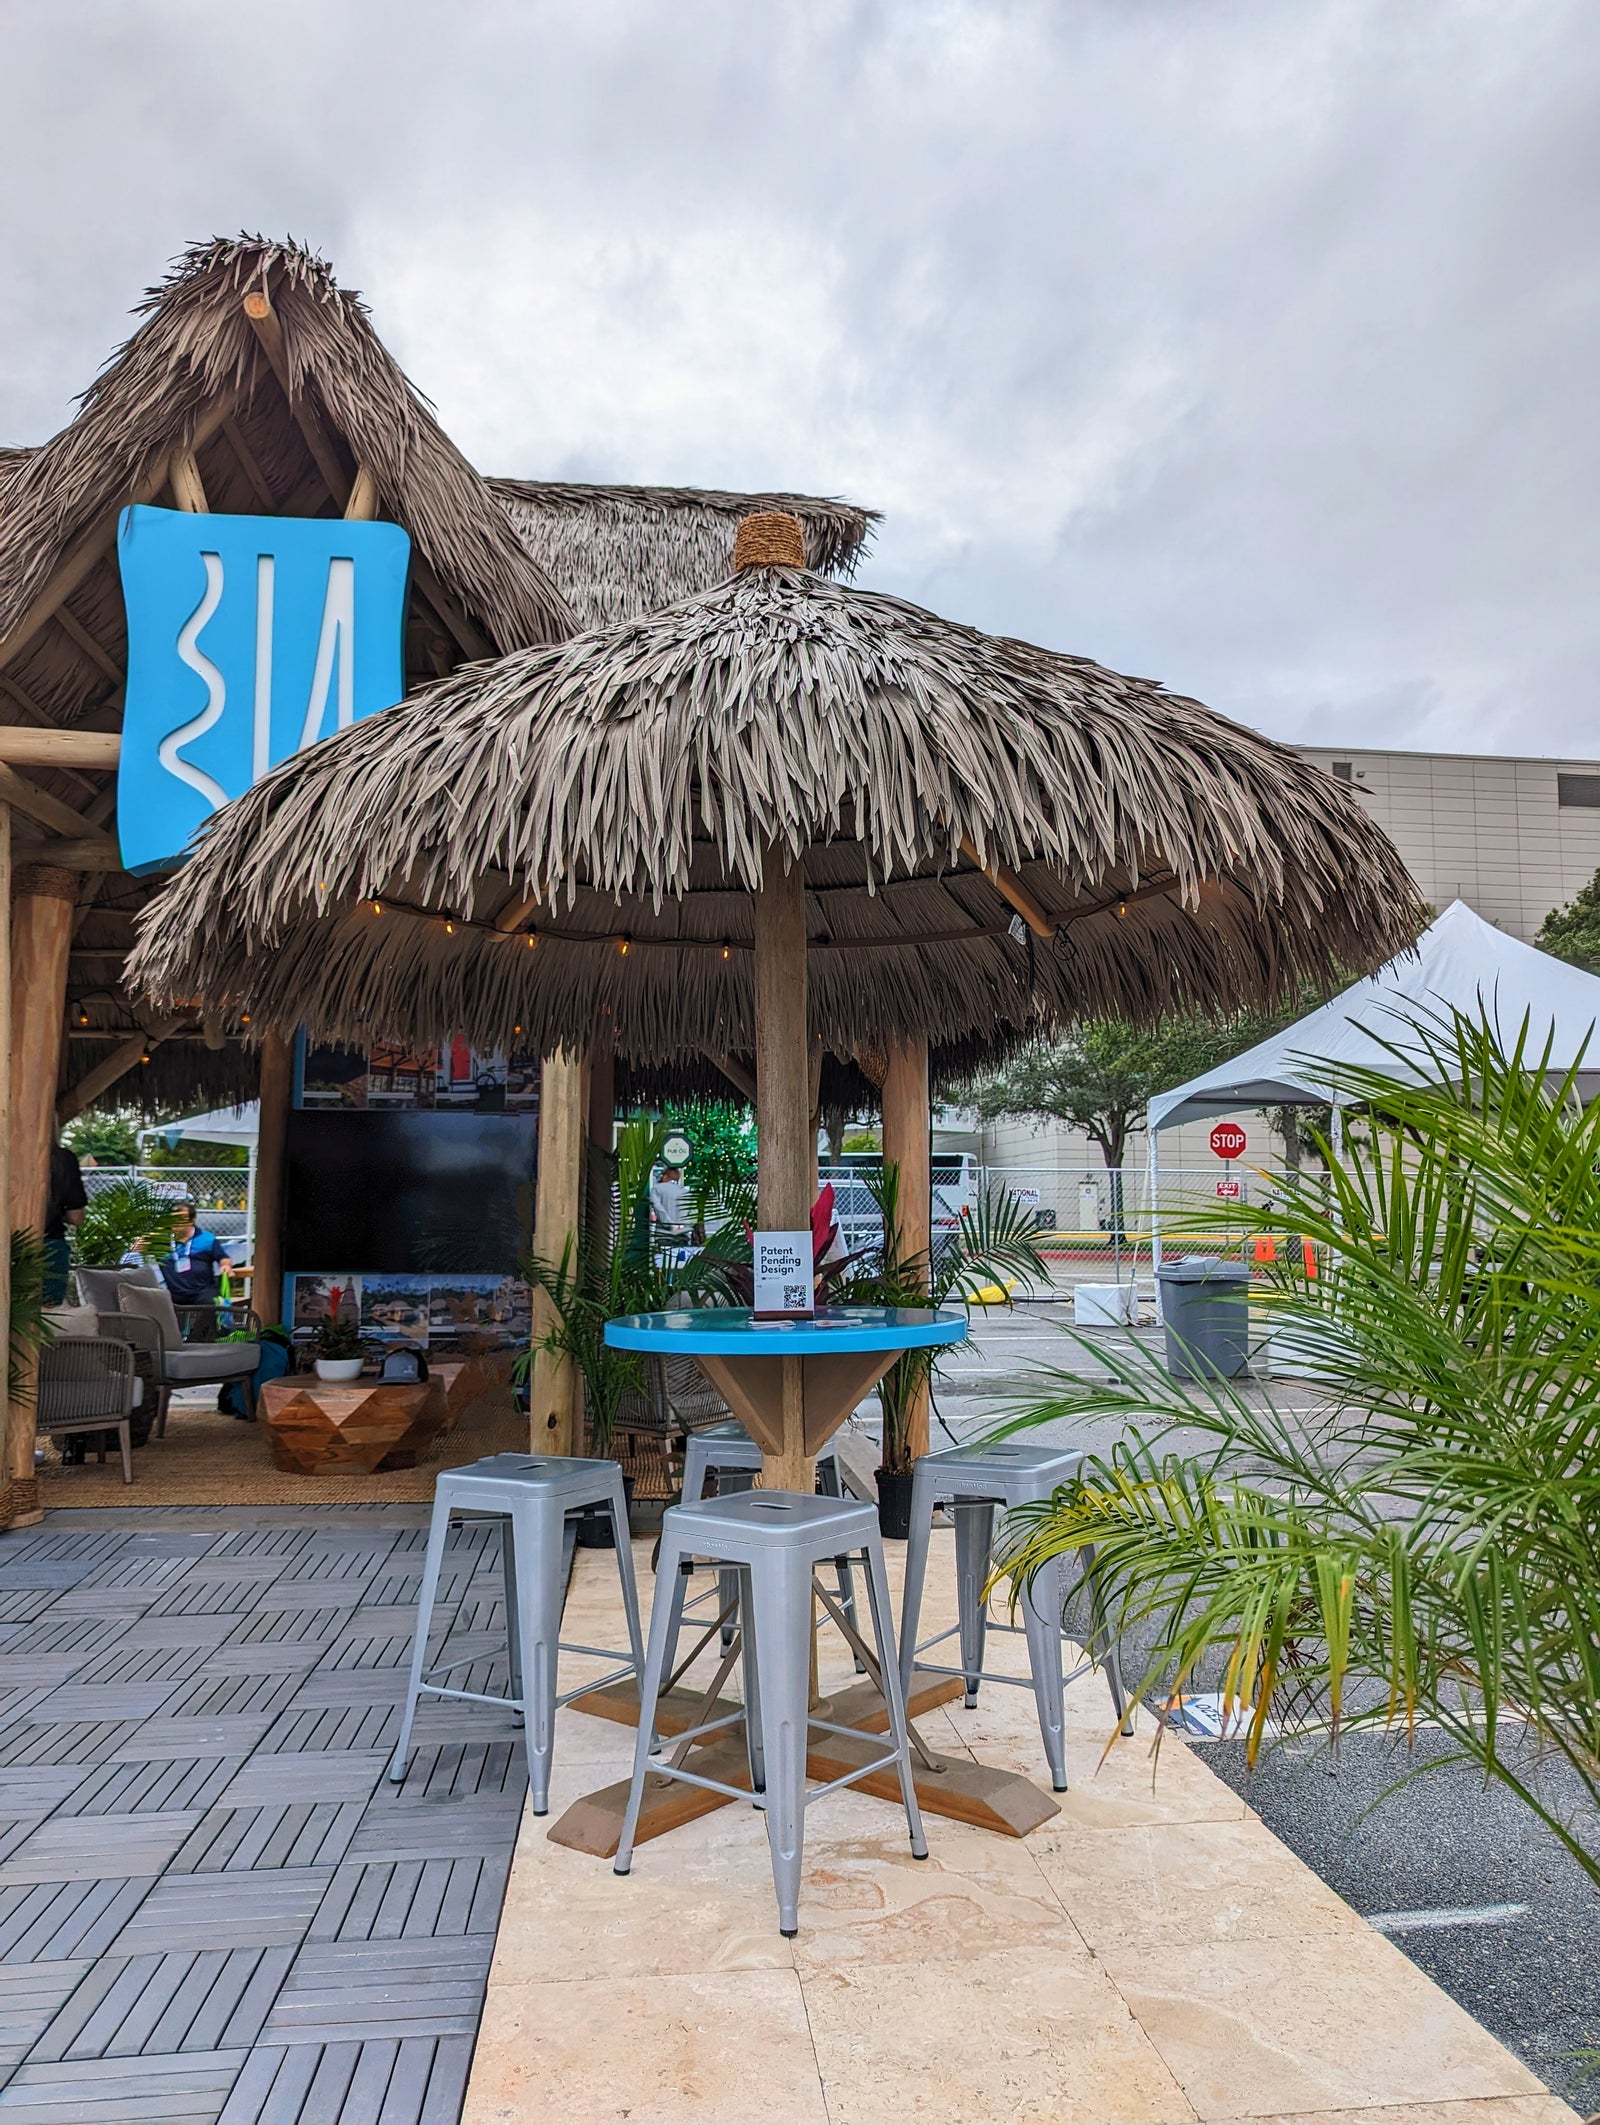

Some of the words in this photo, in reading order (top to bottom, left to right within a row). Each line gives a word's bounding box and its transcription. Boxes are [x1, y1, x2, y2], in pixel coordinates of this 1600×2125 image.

[1212, 1133, 1244, 1148] STOP
[760, 1246, 793, 1255] Patent
[760, 1256, 801, 1267] Pending
[761, 1265, 794, 1276] Design
